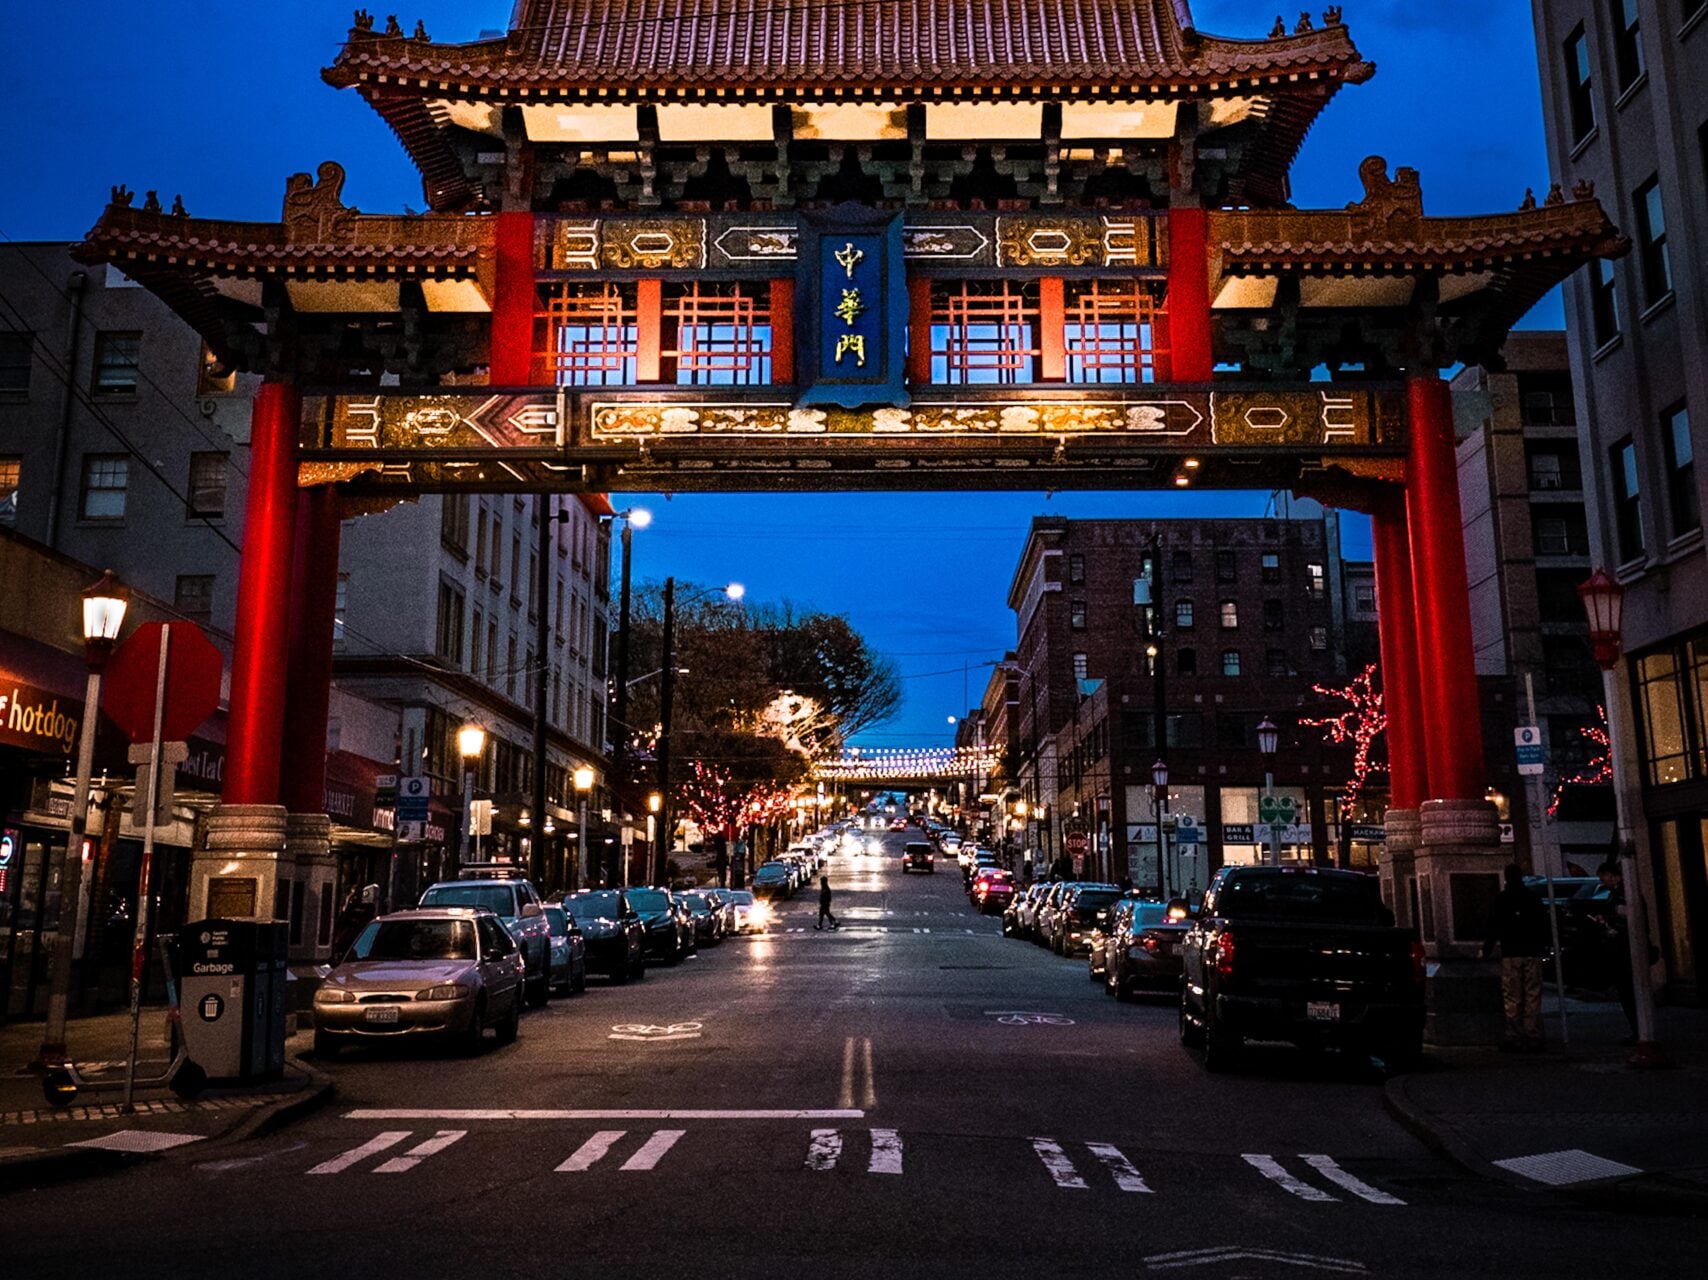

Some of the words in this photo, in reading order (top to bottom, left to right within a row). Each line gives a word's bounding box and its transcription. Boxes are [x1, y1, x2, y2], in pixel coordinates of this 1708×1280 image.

[835, 242, 864, 366] 中華門
[8, 688, 77, 754] hotdog
[1067, 839, 1087, 849] STOP
[193, 962, 234, 974] Garbage
